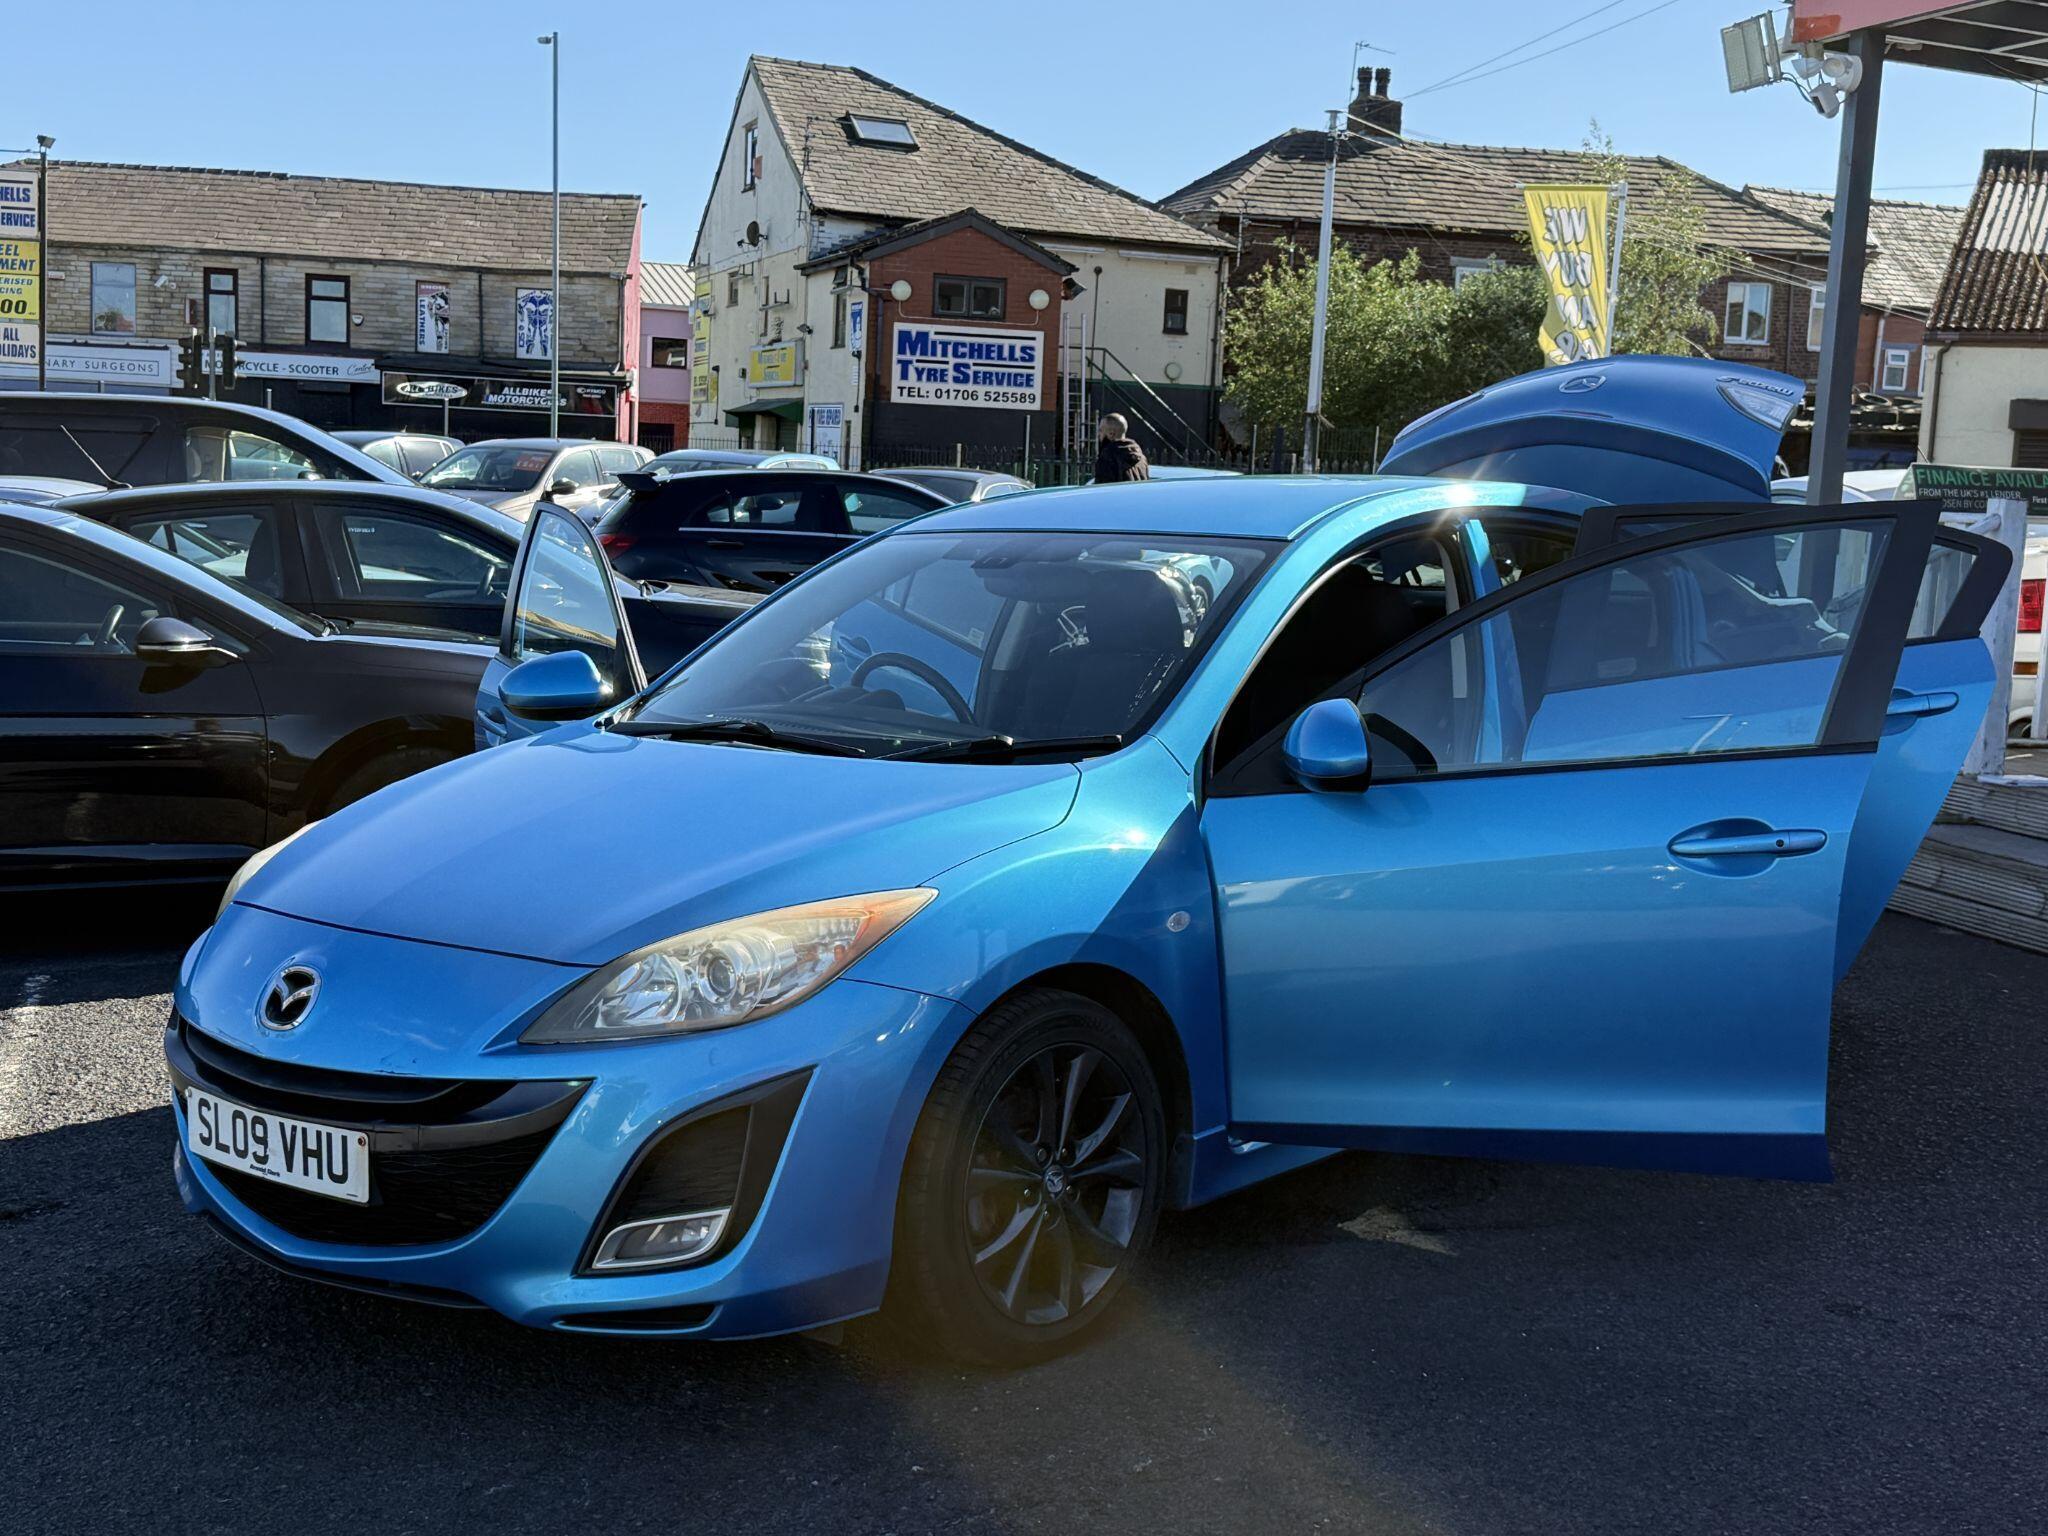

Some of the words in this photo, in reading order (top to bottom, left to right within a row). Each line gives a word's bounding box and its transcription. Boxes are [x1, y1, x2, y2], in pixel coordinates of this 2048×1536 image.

[3, 328, 20, 341] ALL
[0, 343, 36, 358] LIDAYS
[897, 330, 1035, 363] MITCHELLS
[85, 361, 154, 372] SURGEONS
[289, 364, 339, 376] SCOOTER
[897, 359, 949, 383] TYRE
[952, 362, 1034, 388] SERVICE
[488, 394, 567, 406] MOTORCYCLS
[897, 386, 930, 398] TEL:
[934, 388, 979, 401] 01706
[984, 391, 1036, 404] 525589
[1916, 468, 1993, 487] FINANCE
[1919, 488, 1942, 497] FROM
[1944, 489, 1958, 497] THE
[198, 1098, 269, 1165] SL09
[279, 1121, 348, 1185] VHU
